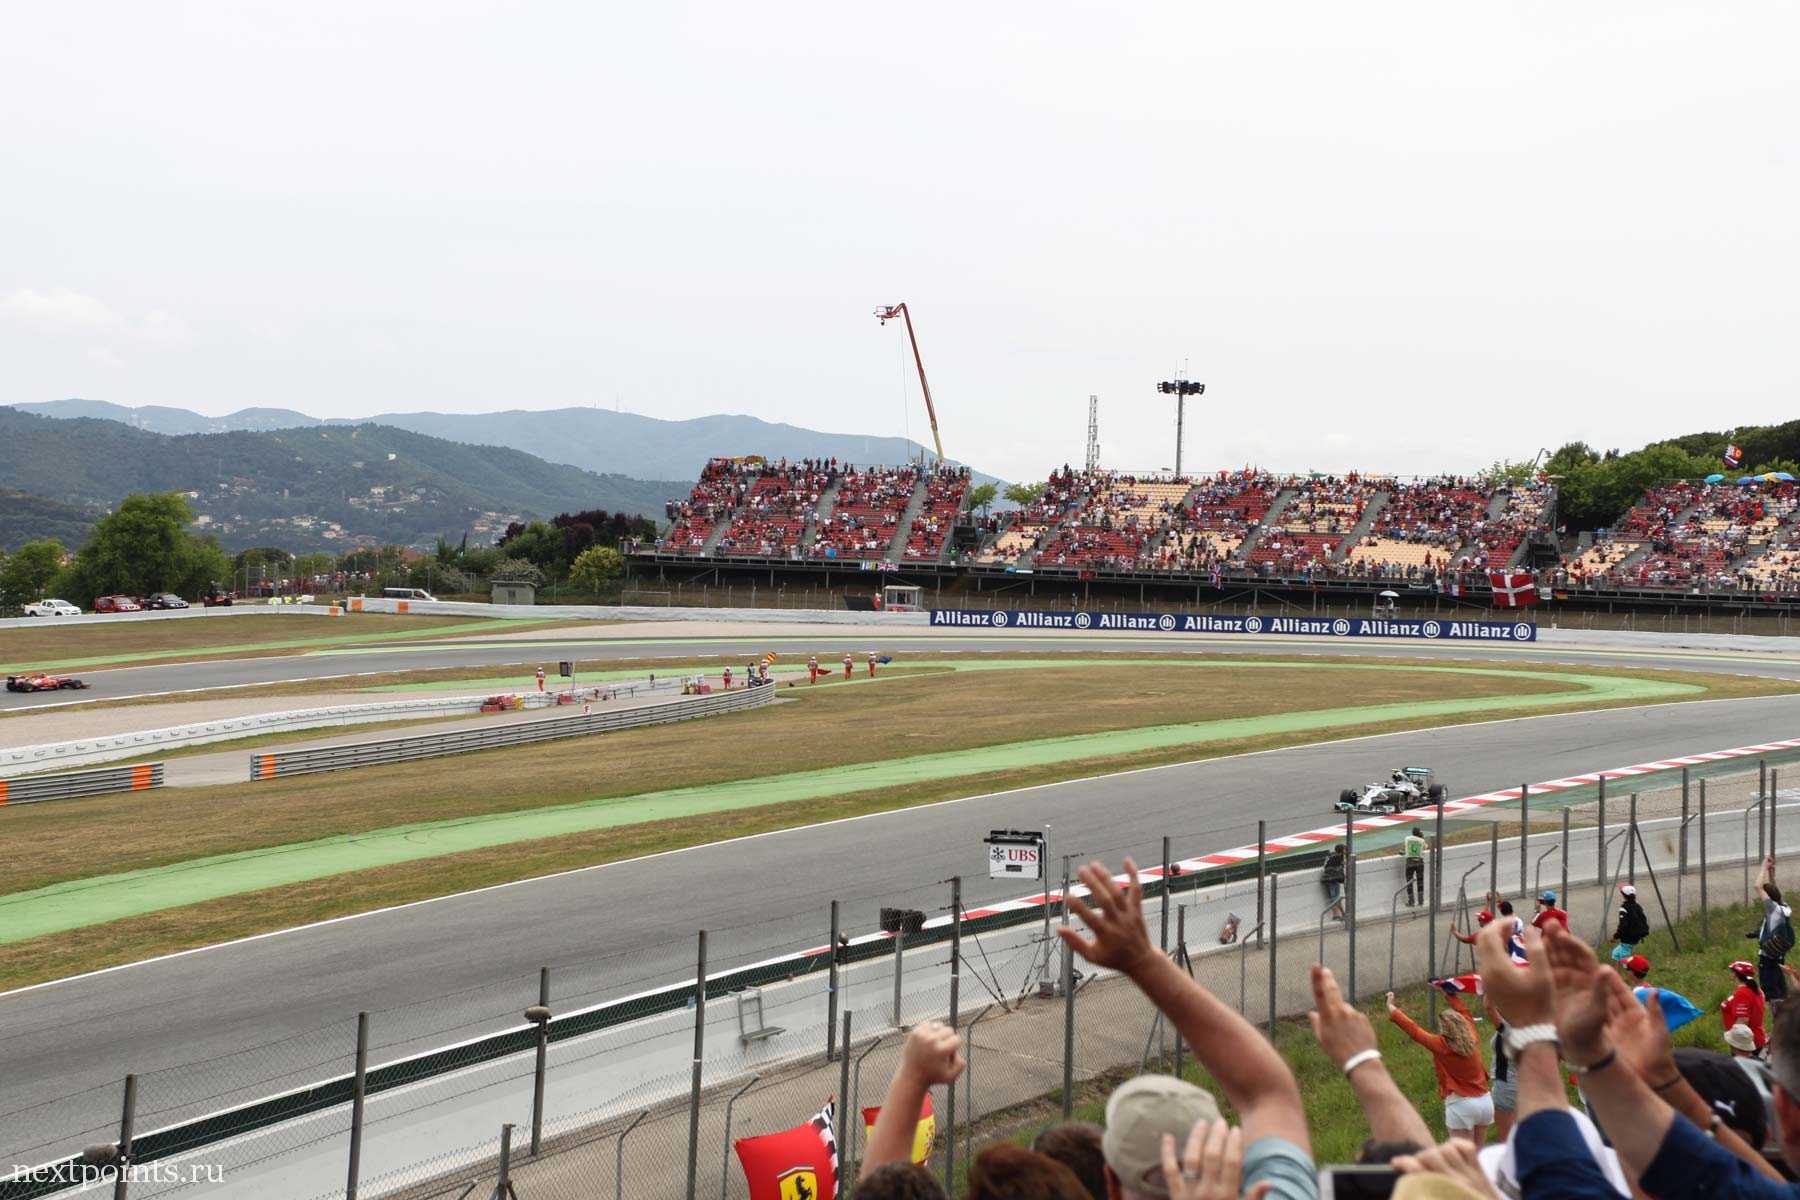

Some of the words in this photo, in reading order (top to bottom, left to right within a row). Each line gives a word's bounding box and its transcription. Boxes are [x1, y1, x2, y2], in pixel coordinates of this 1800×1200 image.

[934, 610, 989, 624] Allianz
[1015, 612, 1072, 627] Allianz
[1100, 614, 1157, 628] Allianz
[1185, 616, 1243, 630] Allianz
[1270, 618, 1330, 632] Allianz
[1360, 620, 1420, 635] Allianz
[1449, 622, 1511, 638] Allianz
[1008, 848, 1037, 861] UBS
